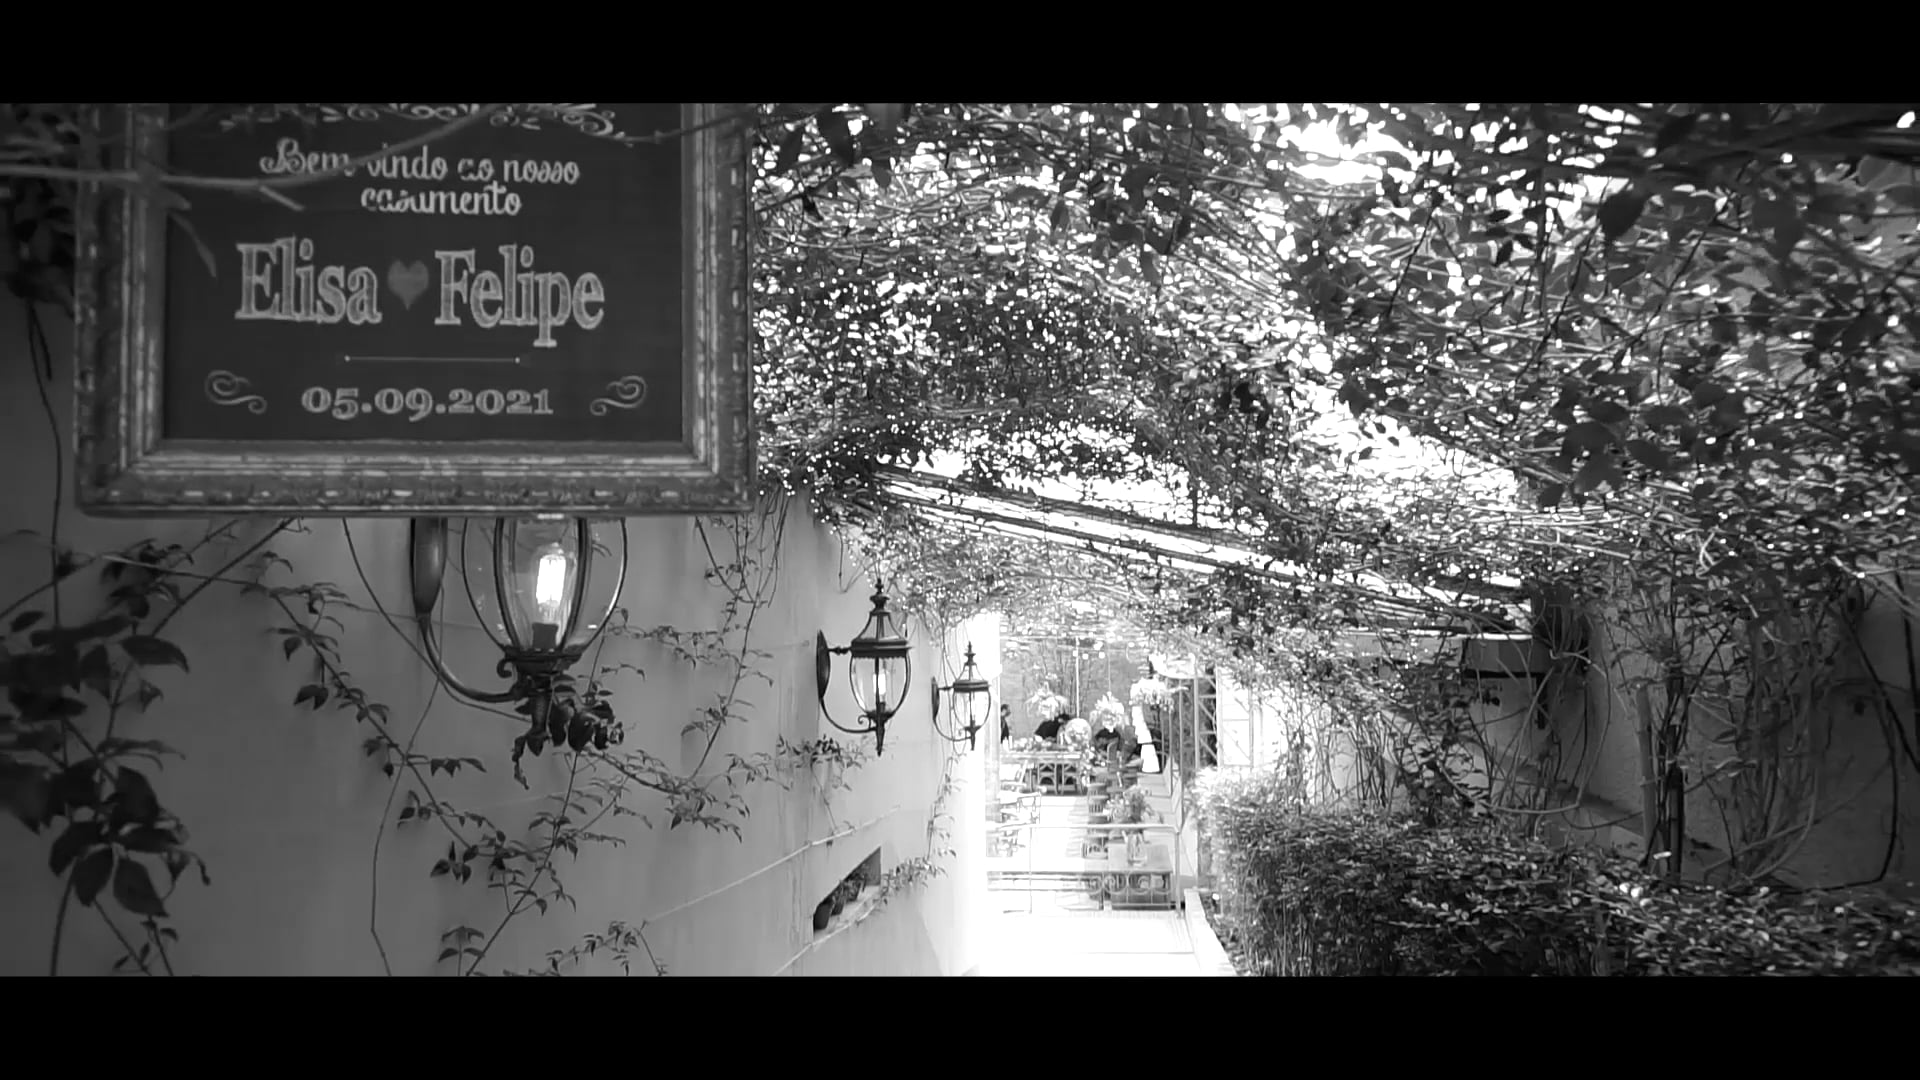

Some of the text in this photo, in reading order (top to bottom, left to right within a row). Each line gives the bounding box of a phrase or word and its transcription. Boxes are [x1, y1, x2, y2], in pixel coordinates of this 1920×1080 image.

[457, 157, 495, 181] ao
[503, 158, 580, 184] nosso
[235, 236, 605, 347] Elisa Felipe
[301, 386, 553, 421] 05.09.2021
